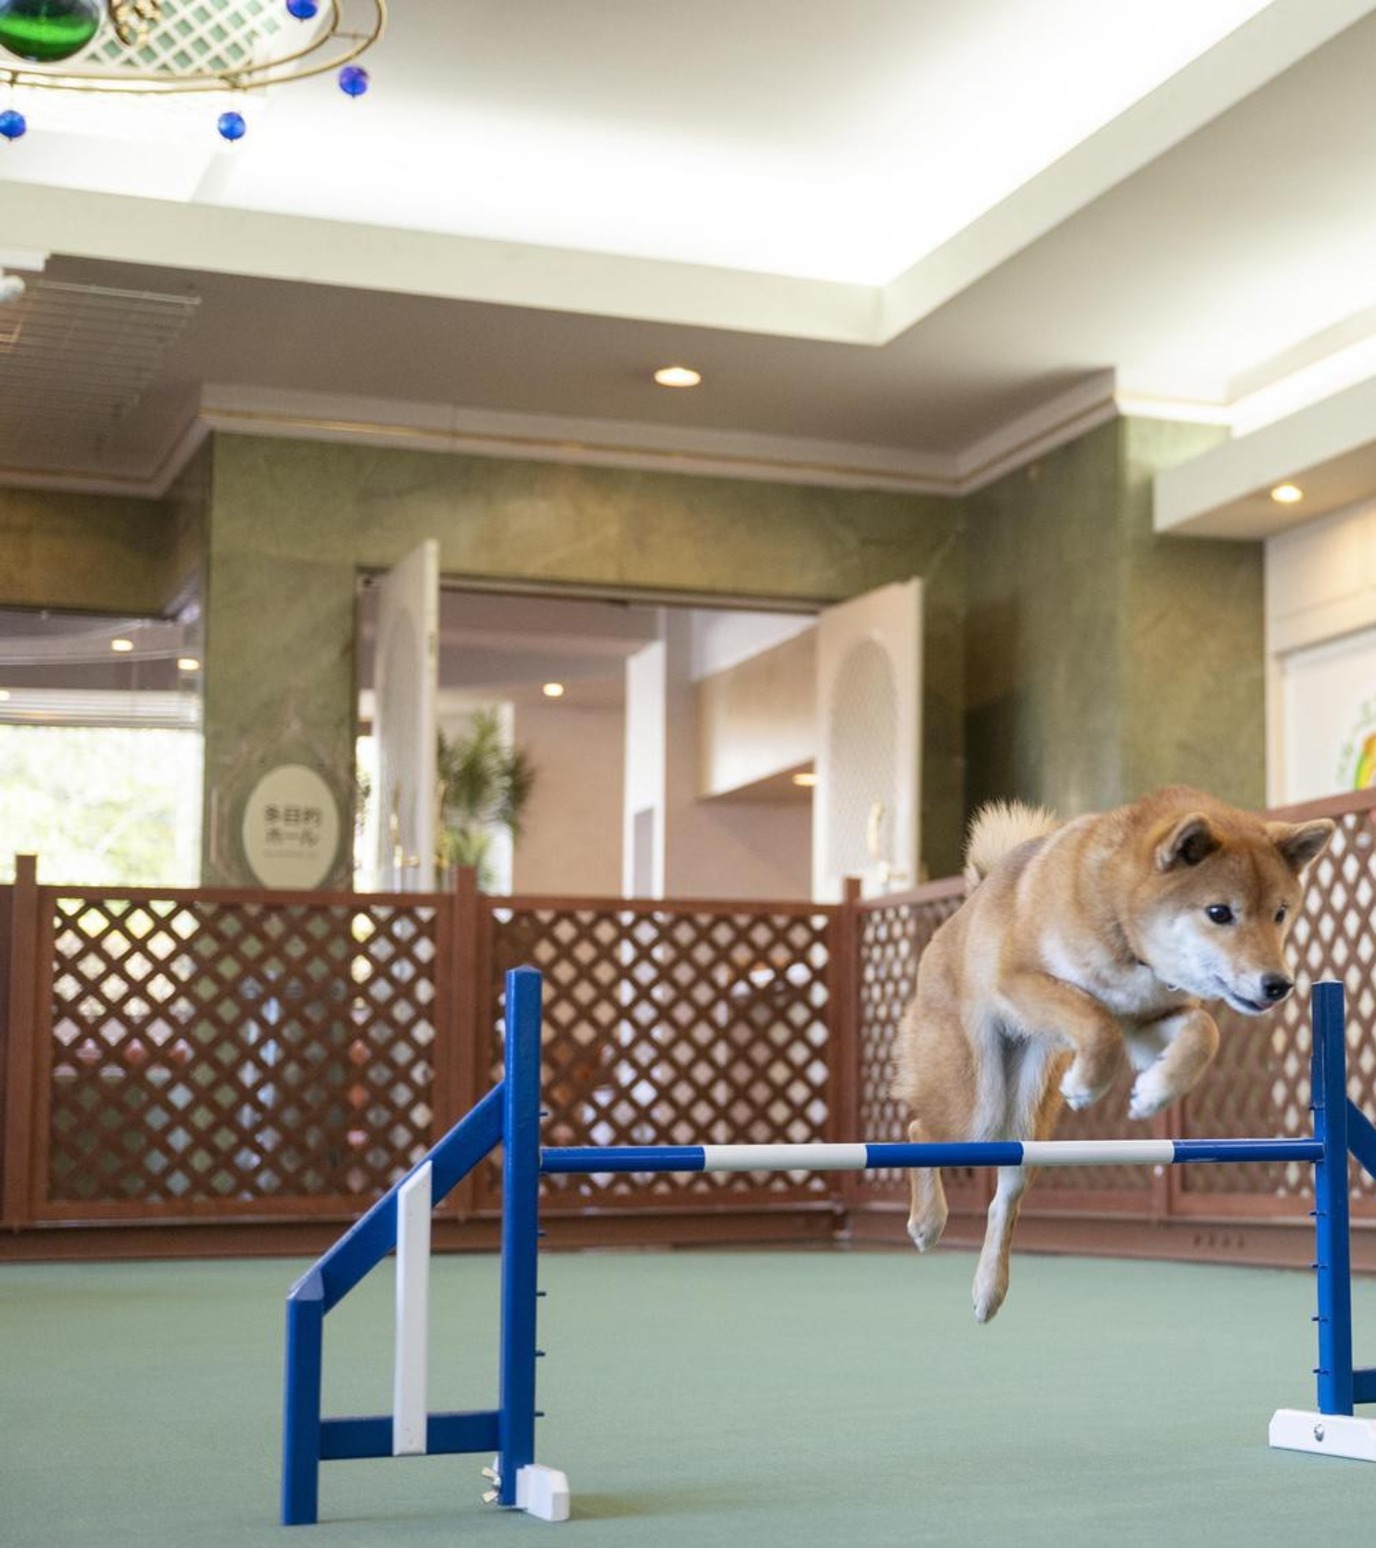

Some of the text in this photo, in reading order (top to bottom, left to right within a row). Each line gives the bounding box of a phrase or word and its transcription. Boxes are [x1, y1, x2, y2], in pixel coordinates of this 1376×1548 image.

[264, 803, 322, 828] 多目的
[265, 828, 320, 847] ホール
